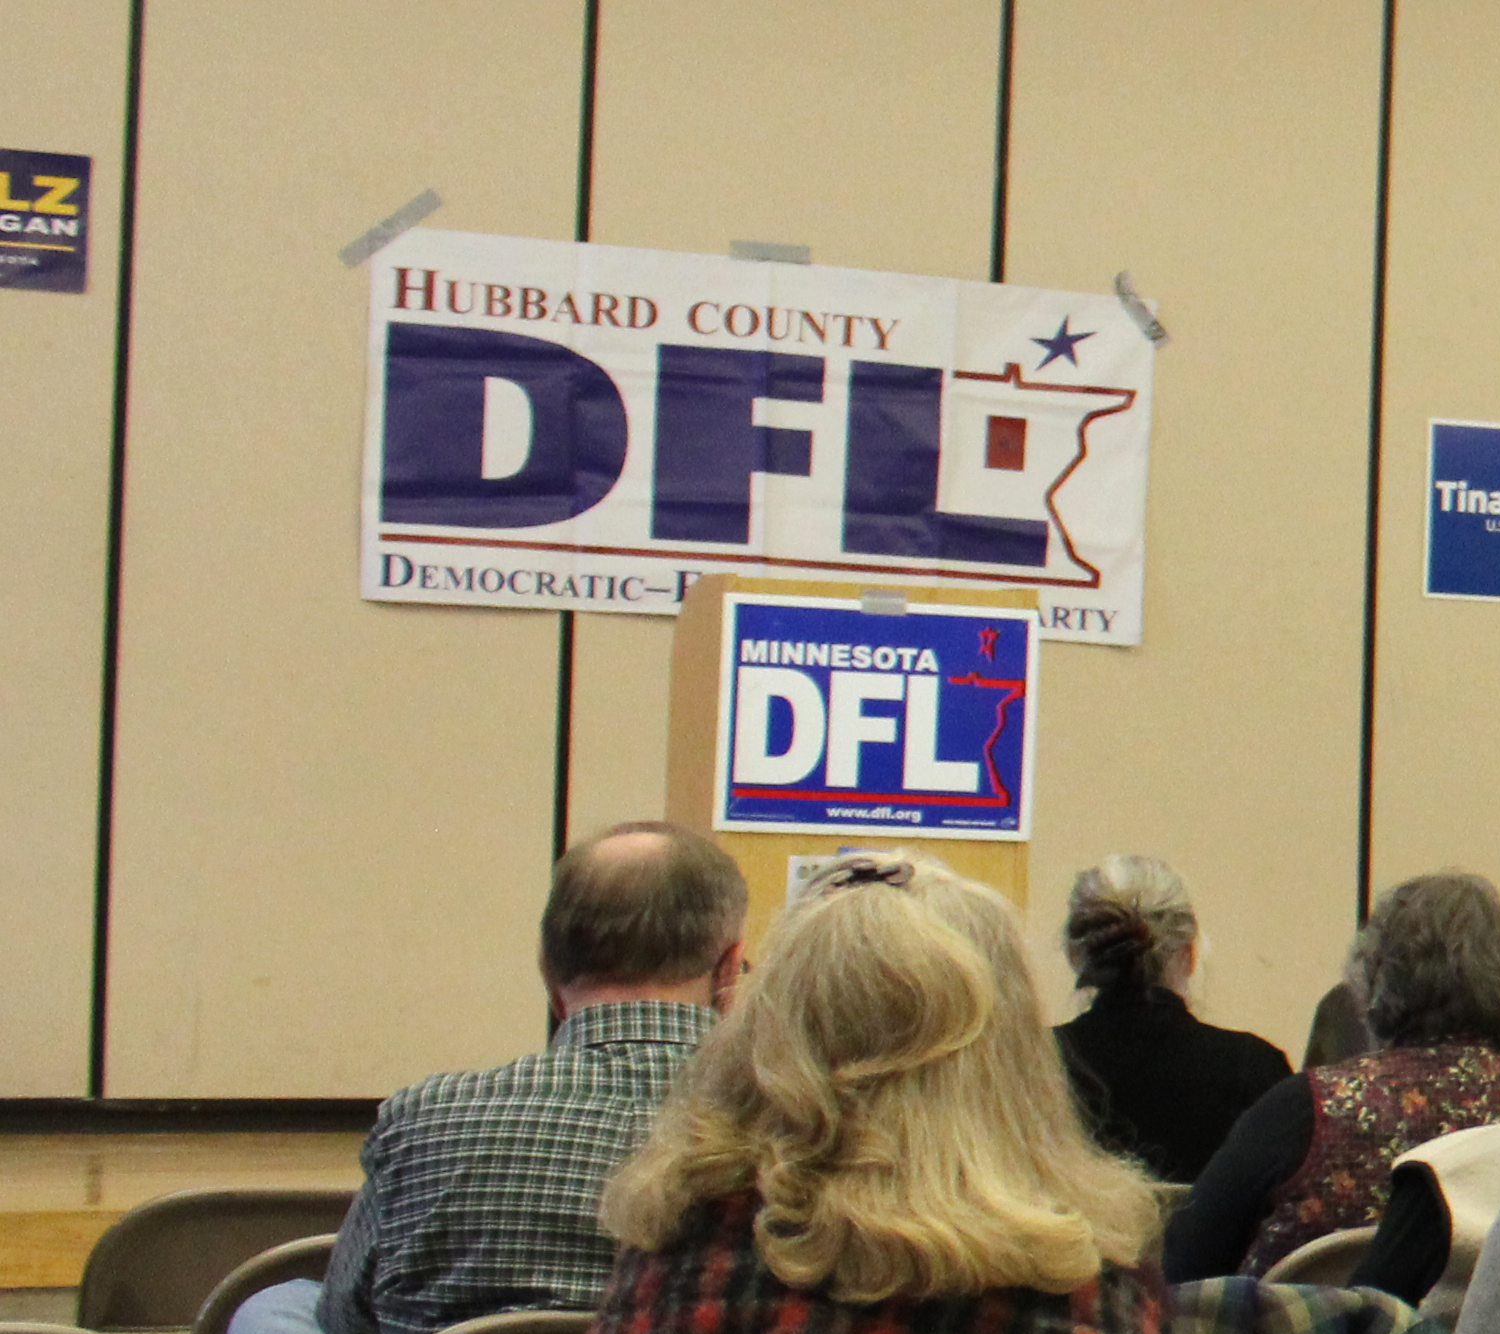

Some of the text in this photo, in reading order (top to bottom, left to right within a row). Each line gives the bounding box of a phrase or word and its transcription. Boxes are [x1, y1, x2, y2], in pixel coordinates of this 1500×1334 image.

[379, 321, 1050, 567] DFL
[740, 638, 939, 673] MINNESOTA
[732, 665, 981, 793] DFL
[826, 805, 922, 824] www.dfl.org
